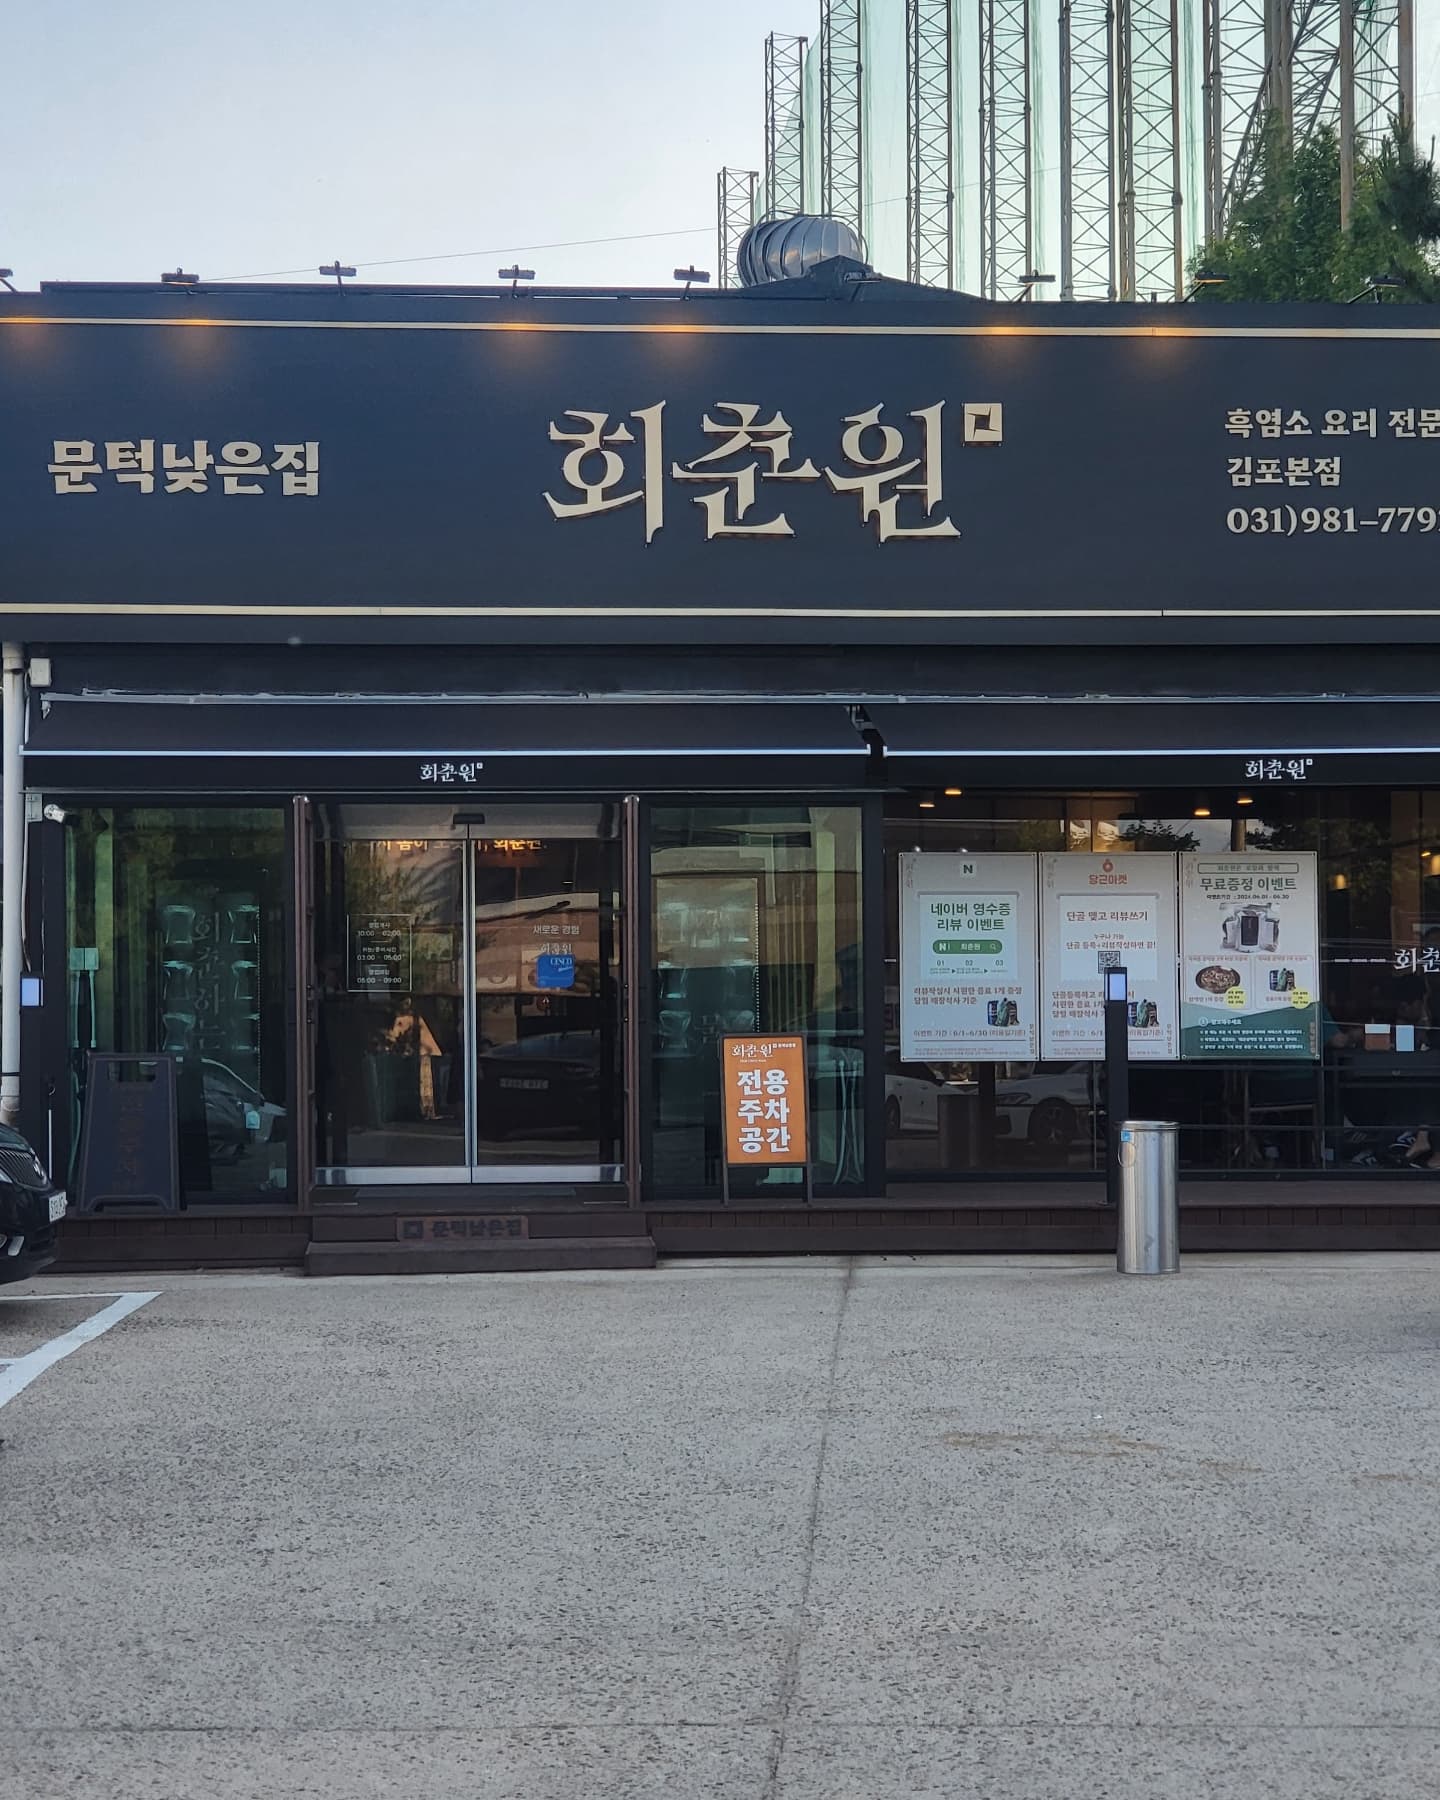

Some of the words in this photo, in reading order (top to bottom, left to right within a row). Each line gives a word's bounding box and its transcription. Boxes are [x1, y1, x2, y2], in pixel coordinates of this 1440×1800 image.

[1225, 407, 1313, 438] 흑염소
[1321, 407, 1377, 438] 요리
[1388, 407, 1440, 438] 전문
[47, 438, 320, 496] 문턱낮은집
[541, 399, 962, 544] 회춘원
[1227, 456, 1341, 487] 김포본점
[1226, 504, 1440, 536] 031)981-779
[420, 762, 477, 783] 회춘원
[1245, 758, 1307, 780] 회춘원
[963, 864, 973, 874] N
[1088, 873, 1128, 885] 당근마켓
[1200, 877, 1253, 891] 무료증정
[1258, 877, 1297, 891] 이벤트
[931, 903, 968, 916] 네이버
[973, 903, 1011, 916] 영수증
[1110, 911, 1148, 921] 리뷰쓰기
[533, 924, 560, 935] 새로운
[937, 919, 962, 931] 리뷰
[967, 919, 1005, 931] 이벤트
[737, 1069, 789, 1096] 전용
[738, 1097, 790, 1124] 주차
[738, 1125, 791, 1153] 공간
